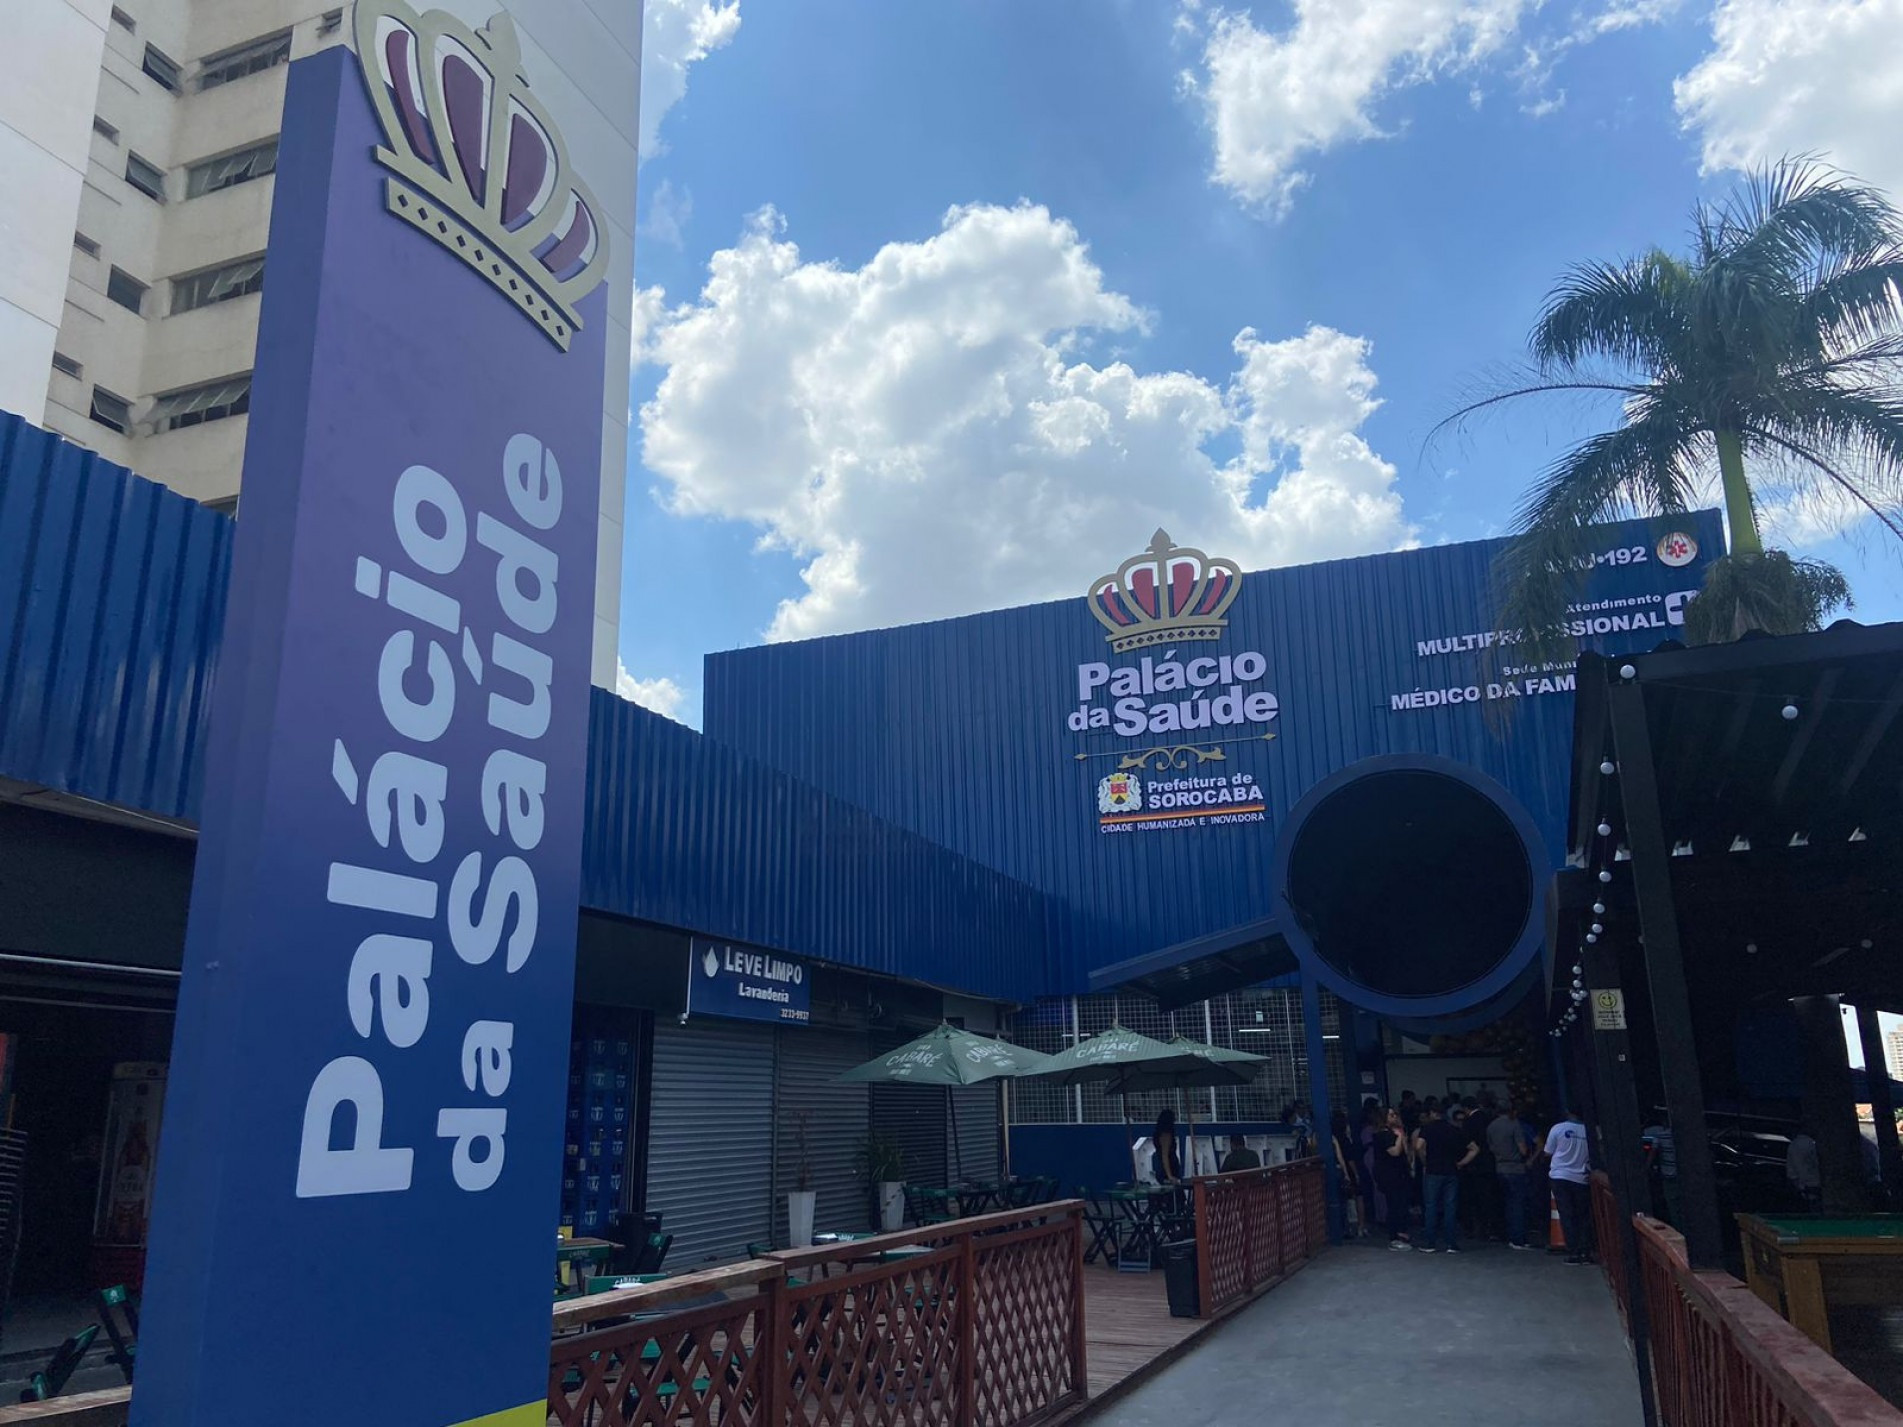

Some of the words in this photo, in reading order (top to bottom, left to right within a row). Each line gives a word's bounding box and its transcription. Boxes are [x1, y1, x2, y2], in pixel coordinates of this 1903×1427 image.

[1566, 594, 1662, 614] Atendimento
[1077, 649, 1267, 700] Palácio
[447, 431, 564, 974] Saúde
[1067, 704, 1110, 732] da
[1112, 685, 1279, 737] Saúde
[1391, 686, 1481, 711] MÉDICO
[1486, 680, 1521, 700] DA
[1148, 776, 1227, 793] Prefeitura
[1231, 772, 1253, 785] de
[1148, 785, 1264, 809] SOROCABA
[296, 463, 467, 1199] Palácio
[1101, 822, 1133, 834] CIDADE
[1137, 818, 1196, 831] HUMANIZADA
[1199, 816, 1206, 826] E
[1210, 812, 1265, 825] INOVADORA
[724, 946, 761, 977] LEVE
[763, 954, 803, 985] LIMPO
[738, 982, 790, 1003] Lavanderia
[437, 1018, 515, 1192] da
